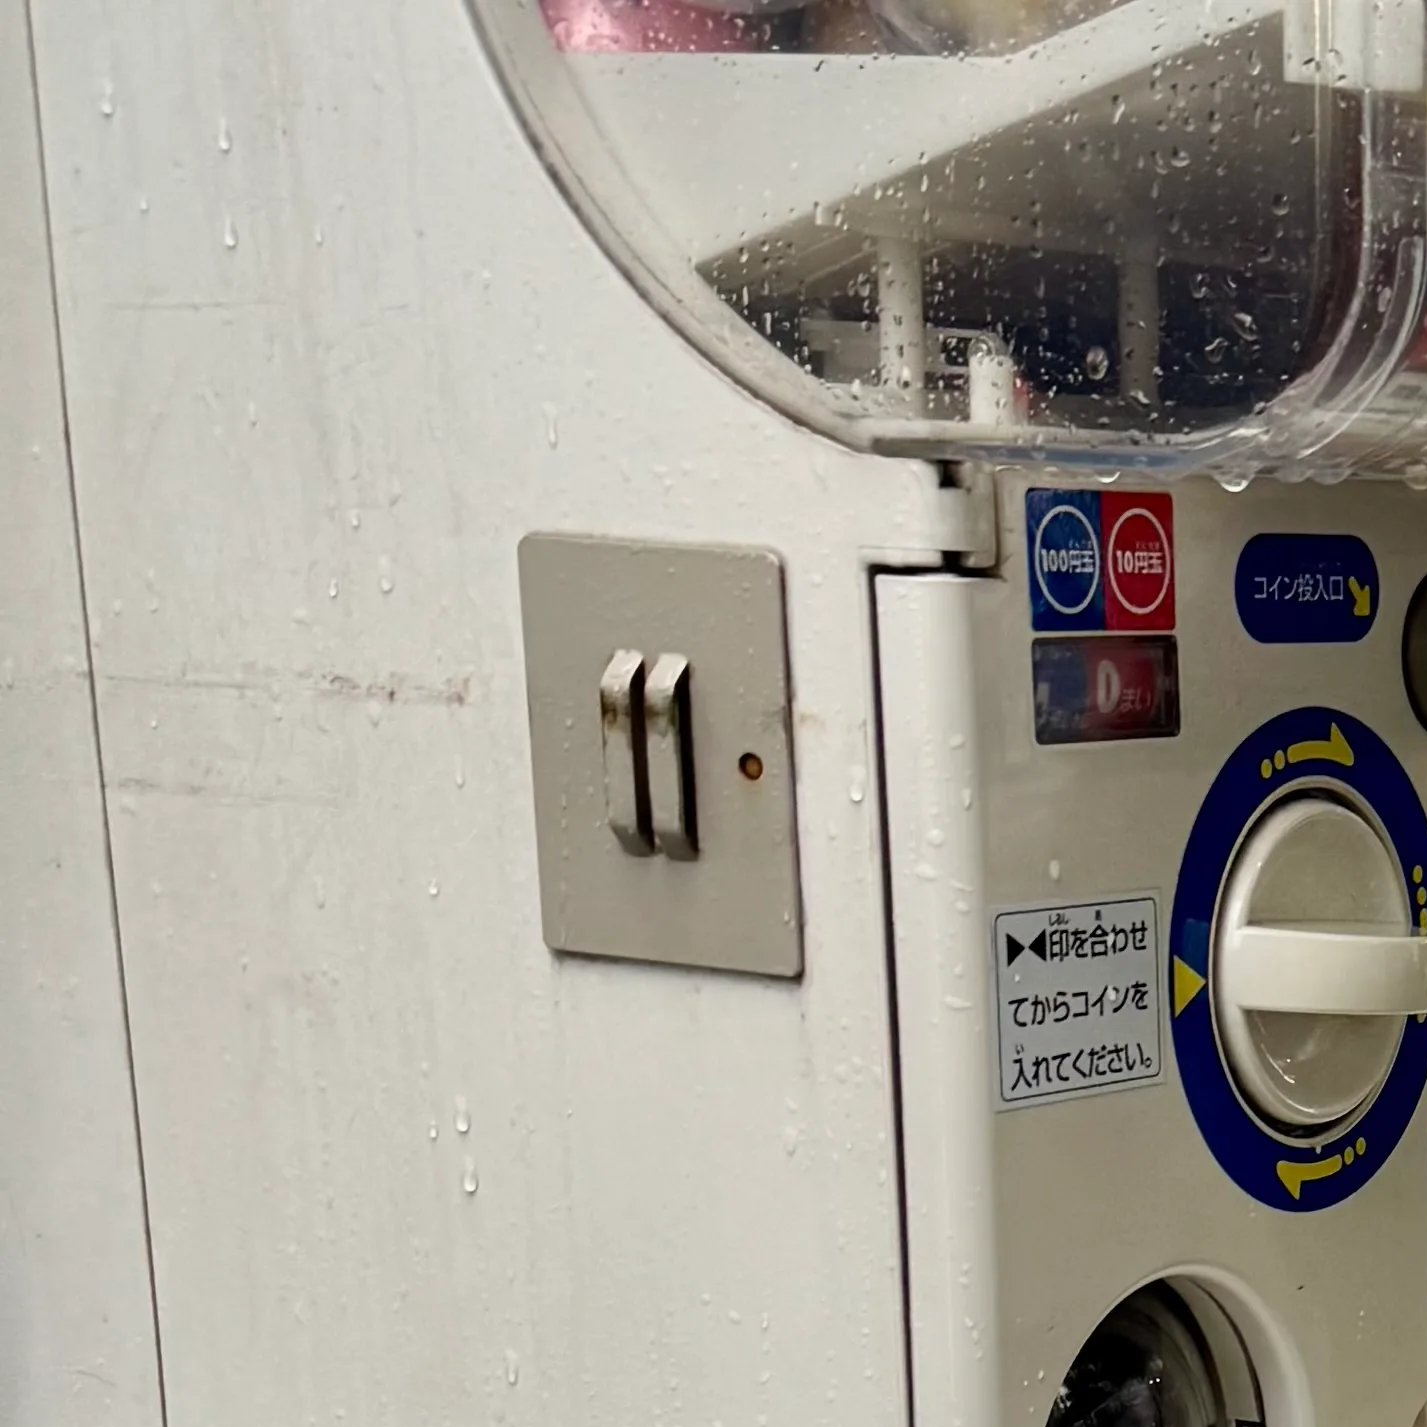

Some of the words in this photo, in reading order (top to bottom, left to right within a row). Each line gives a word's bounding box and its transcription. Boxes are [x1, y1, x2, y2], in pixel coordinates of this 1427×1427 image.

[1041, 549, 1094, 573] 100円玉
[1116, 551, 1162, 574] 10円玉
[1254, 574, 1344, 601] コイン投入口
[1049, 920, 1148, 962] 印を合わせ
[1008, 981, 1148, 1027] てからコインを
[1011, 1043, 1152, 1091] 入れてください。
